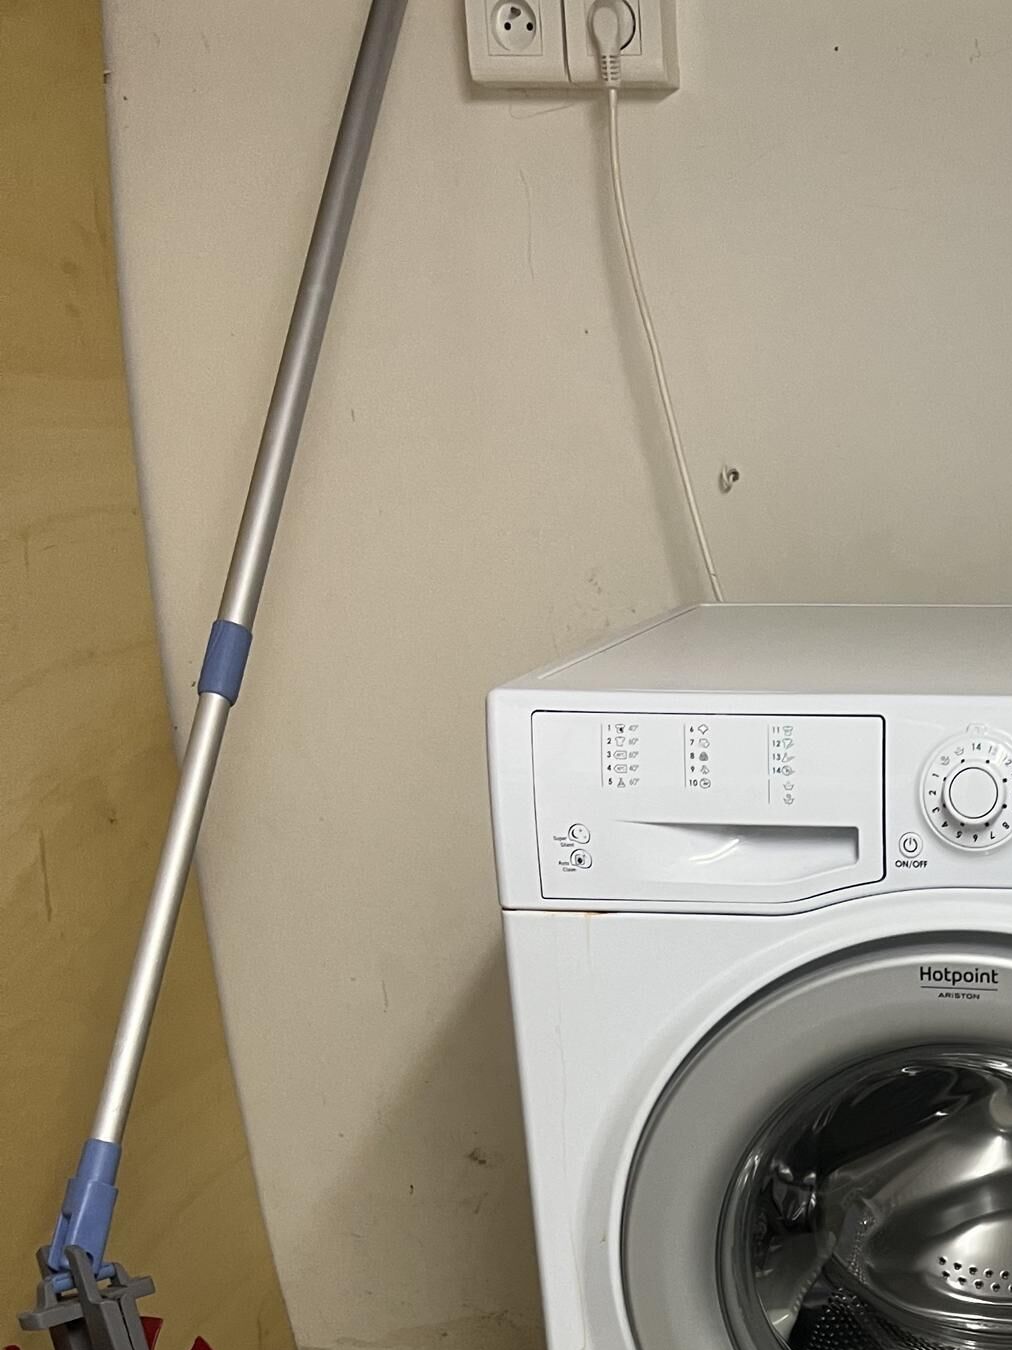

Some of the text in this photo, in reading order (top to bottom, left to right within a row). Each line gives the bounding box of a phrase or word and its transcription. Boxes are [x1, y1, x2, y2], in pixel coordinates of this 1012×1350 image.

[972, 743, 982, 752] 14
[1002, 821, 1010, 830] 8
[956, 830, 963, 839] 5
[895, 860, 928, 869] ON/OFF
[920, 966, 999, 986] Hotpoint
[938, 992, 980, 1000] ARISTON
